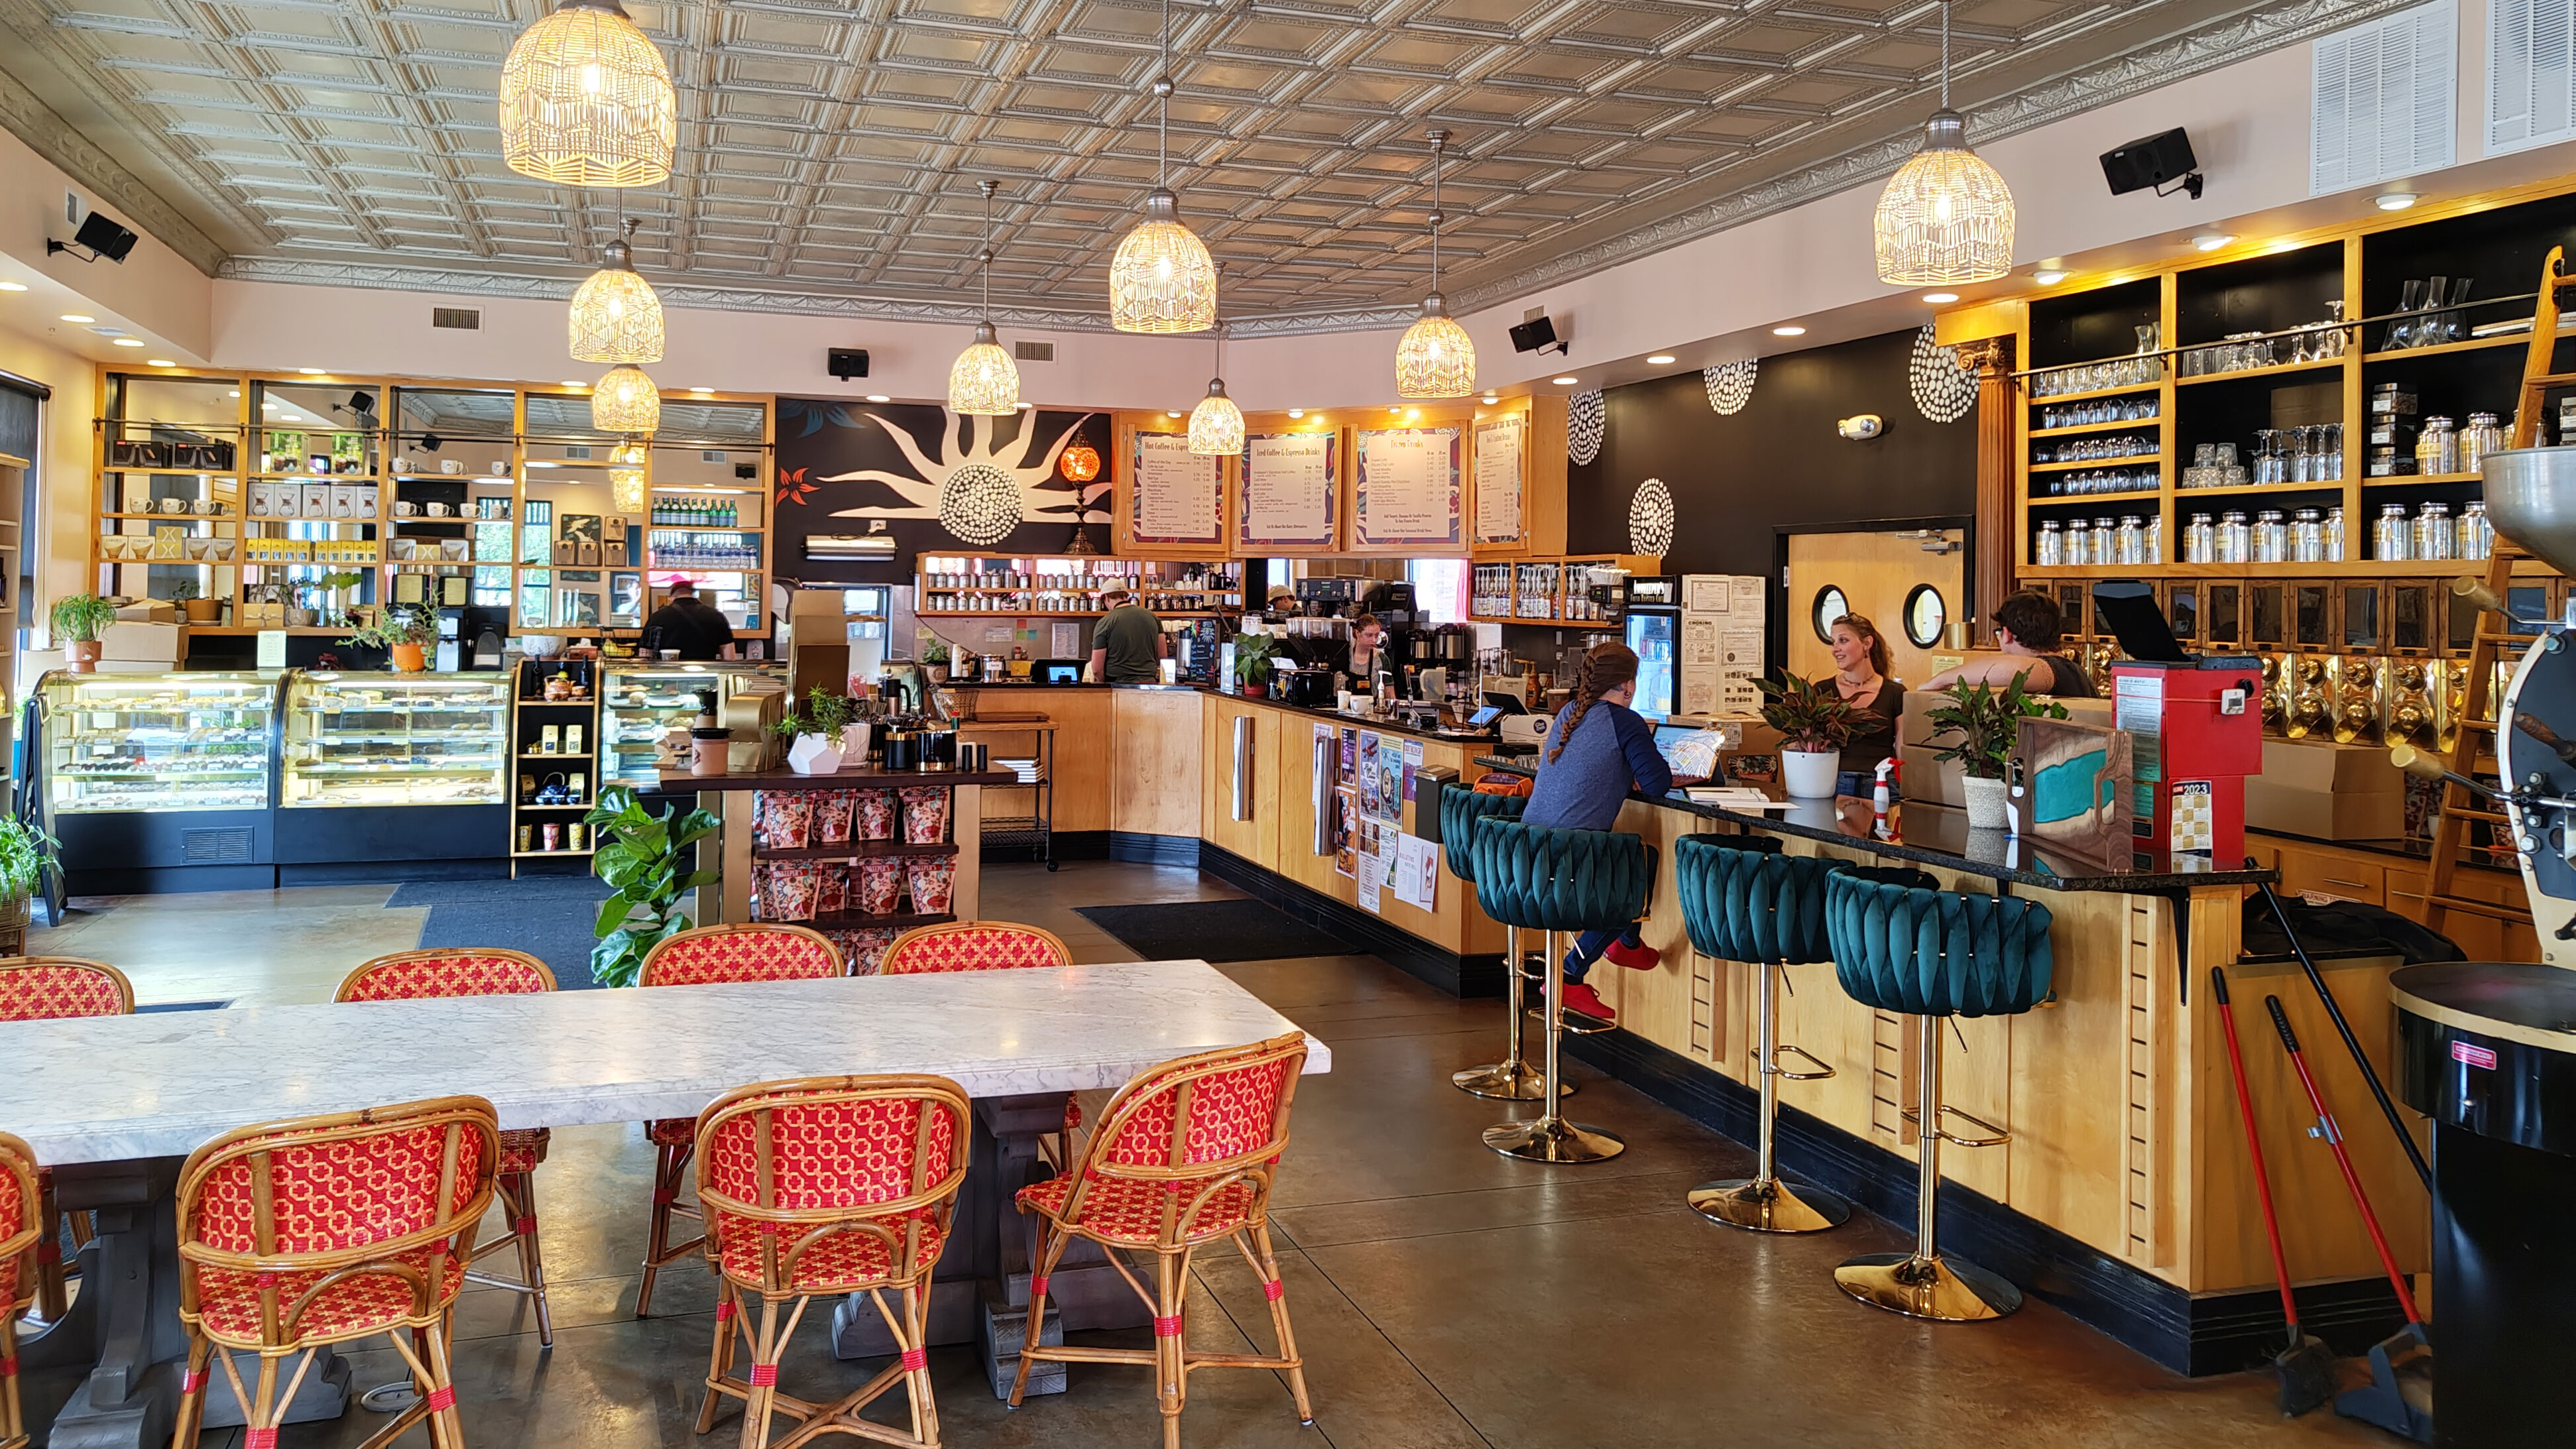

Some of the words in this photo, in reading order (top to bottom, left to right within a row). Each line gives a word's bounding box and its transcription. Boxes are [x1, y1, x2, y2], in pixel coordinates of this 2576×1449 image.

[1176, 443, 1188, 452] Espre
[1286, 448, 1304, 457] Espresso
[2184, 783, 2207, 795] 2023
